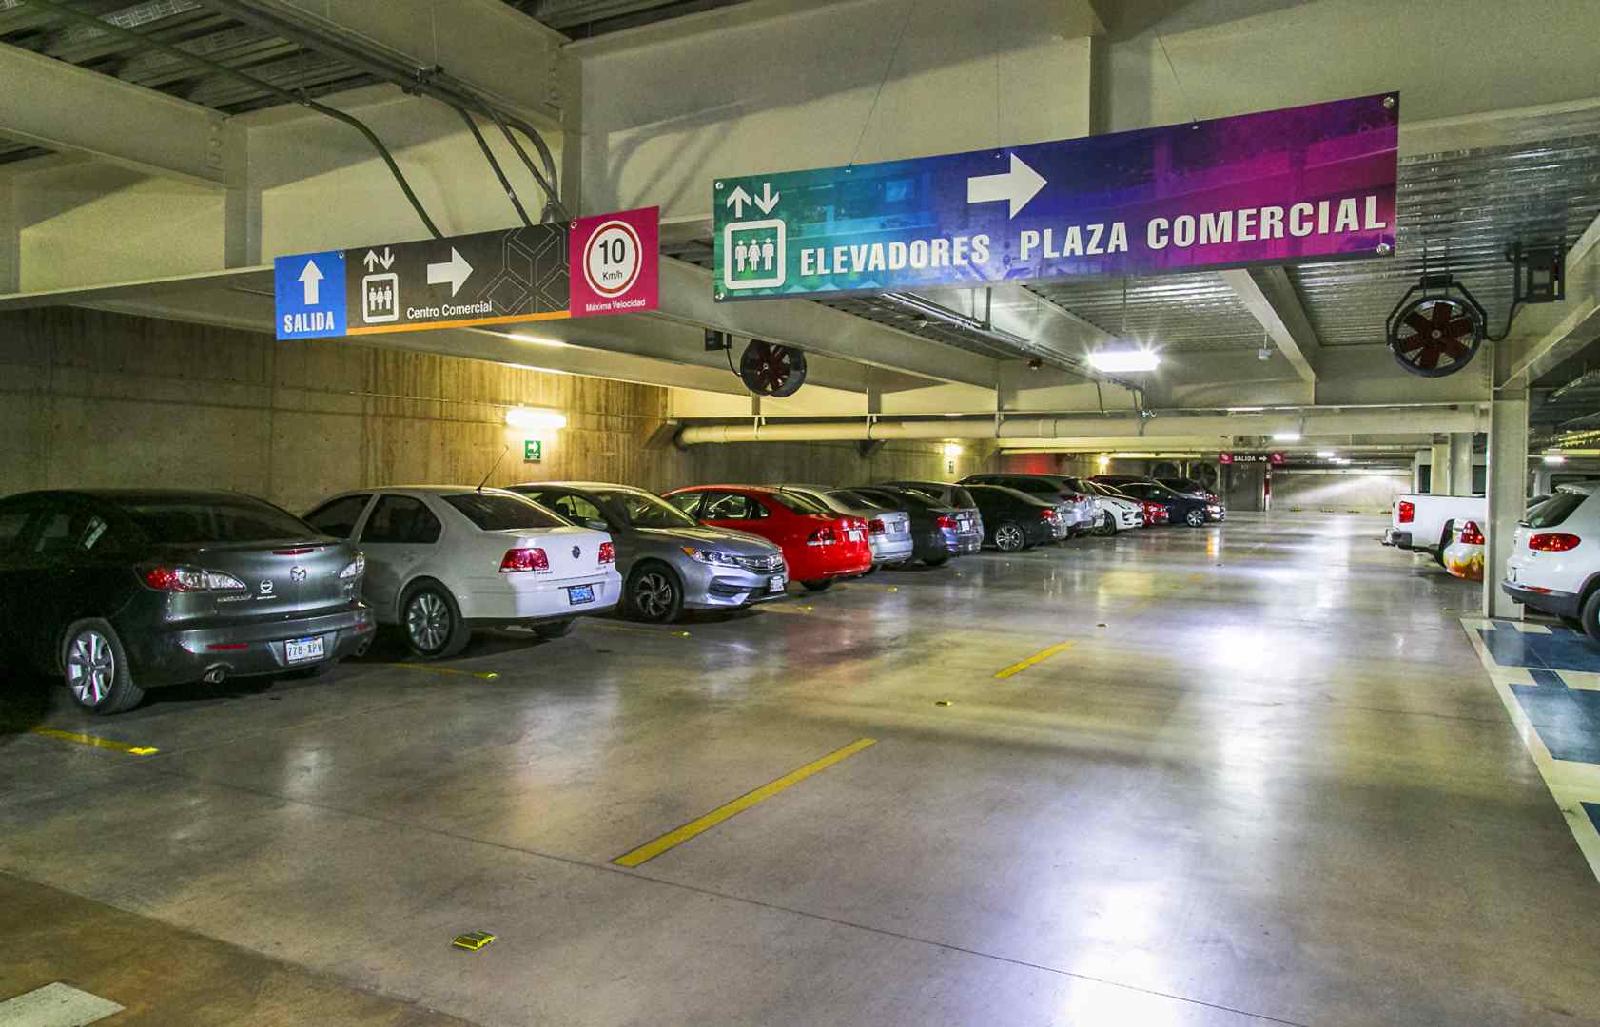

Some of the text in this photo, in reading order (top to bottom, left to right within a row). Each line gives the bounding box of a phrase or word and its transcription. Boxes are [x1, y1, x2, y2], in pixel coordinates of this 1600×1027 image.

[800, 196, 1387, 278] ELEVADORES PLAZA COMERCIAL
[599, 238, 625, 264] 10
[602, 270, 623, 281] Km/h
[406, 301, 492, 320] Centro Comercial
[612, 299, 646, 309] Velocidad
[283, 312, 335, 333] SALIDA
